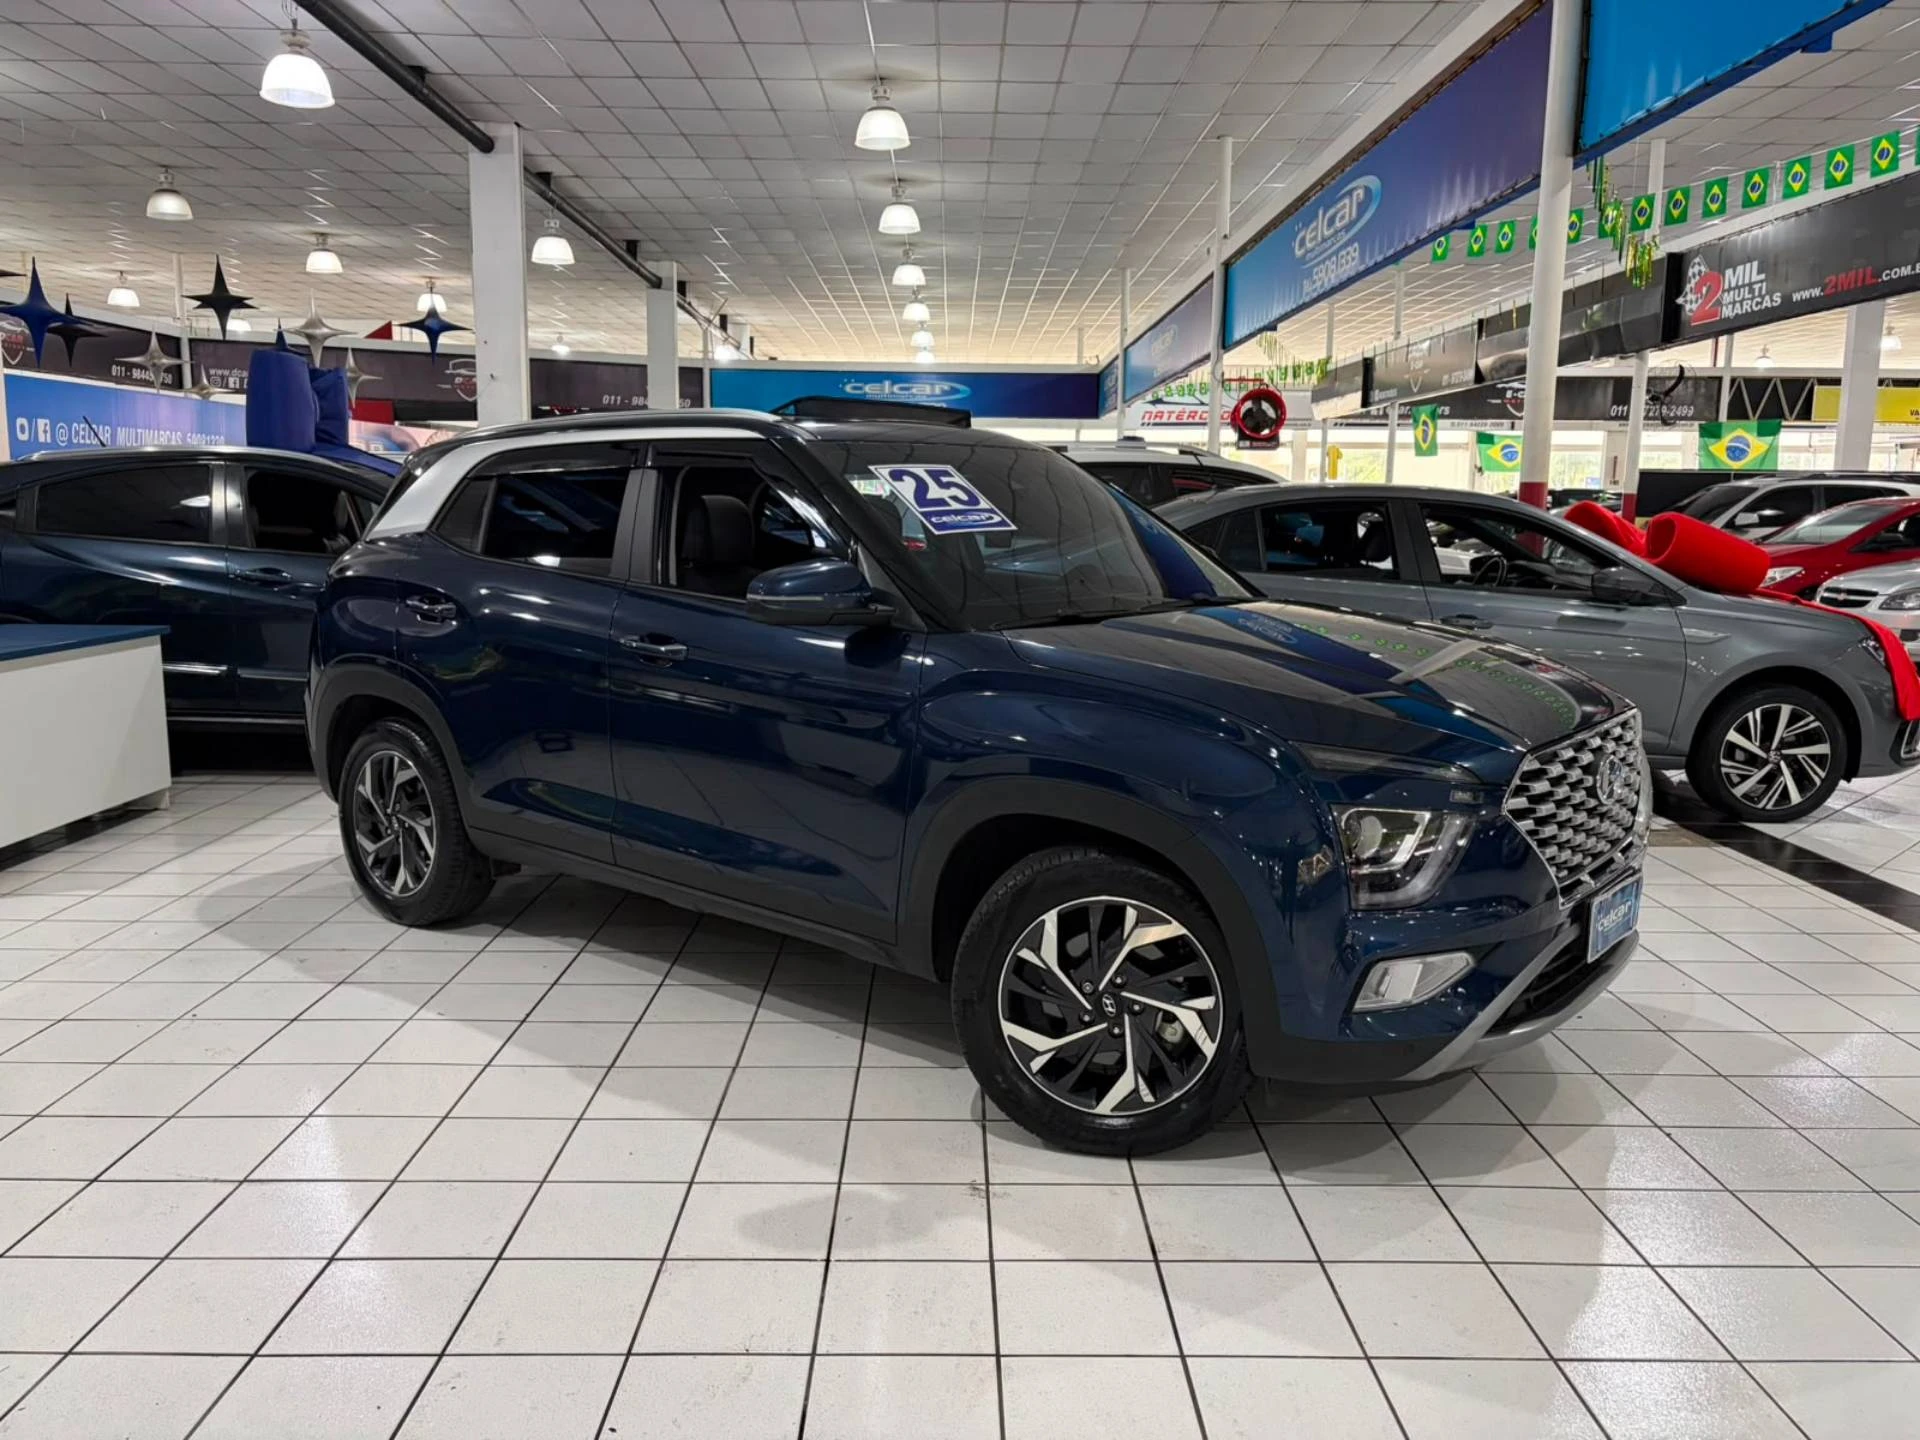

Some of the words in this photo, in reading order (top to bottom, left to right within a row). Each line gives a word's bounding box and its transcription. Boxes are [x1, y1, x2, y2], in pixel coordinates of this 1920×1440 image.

[1295, 184, 1365, 259] celcar
[1724, 260, 1765, 290] MIL
[1690, 270, 1723, 326] 2
[1721, 292, 1782, 319] MARCAS
[1723, 282, 1766, 305] MULTI
[602, 394, 621, 406] 011
[844, 380, 950, 395] celcar
[888, 469, 982, 508] 25
